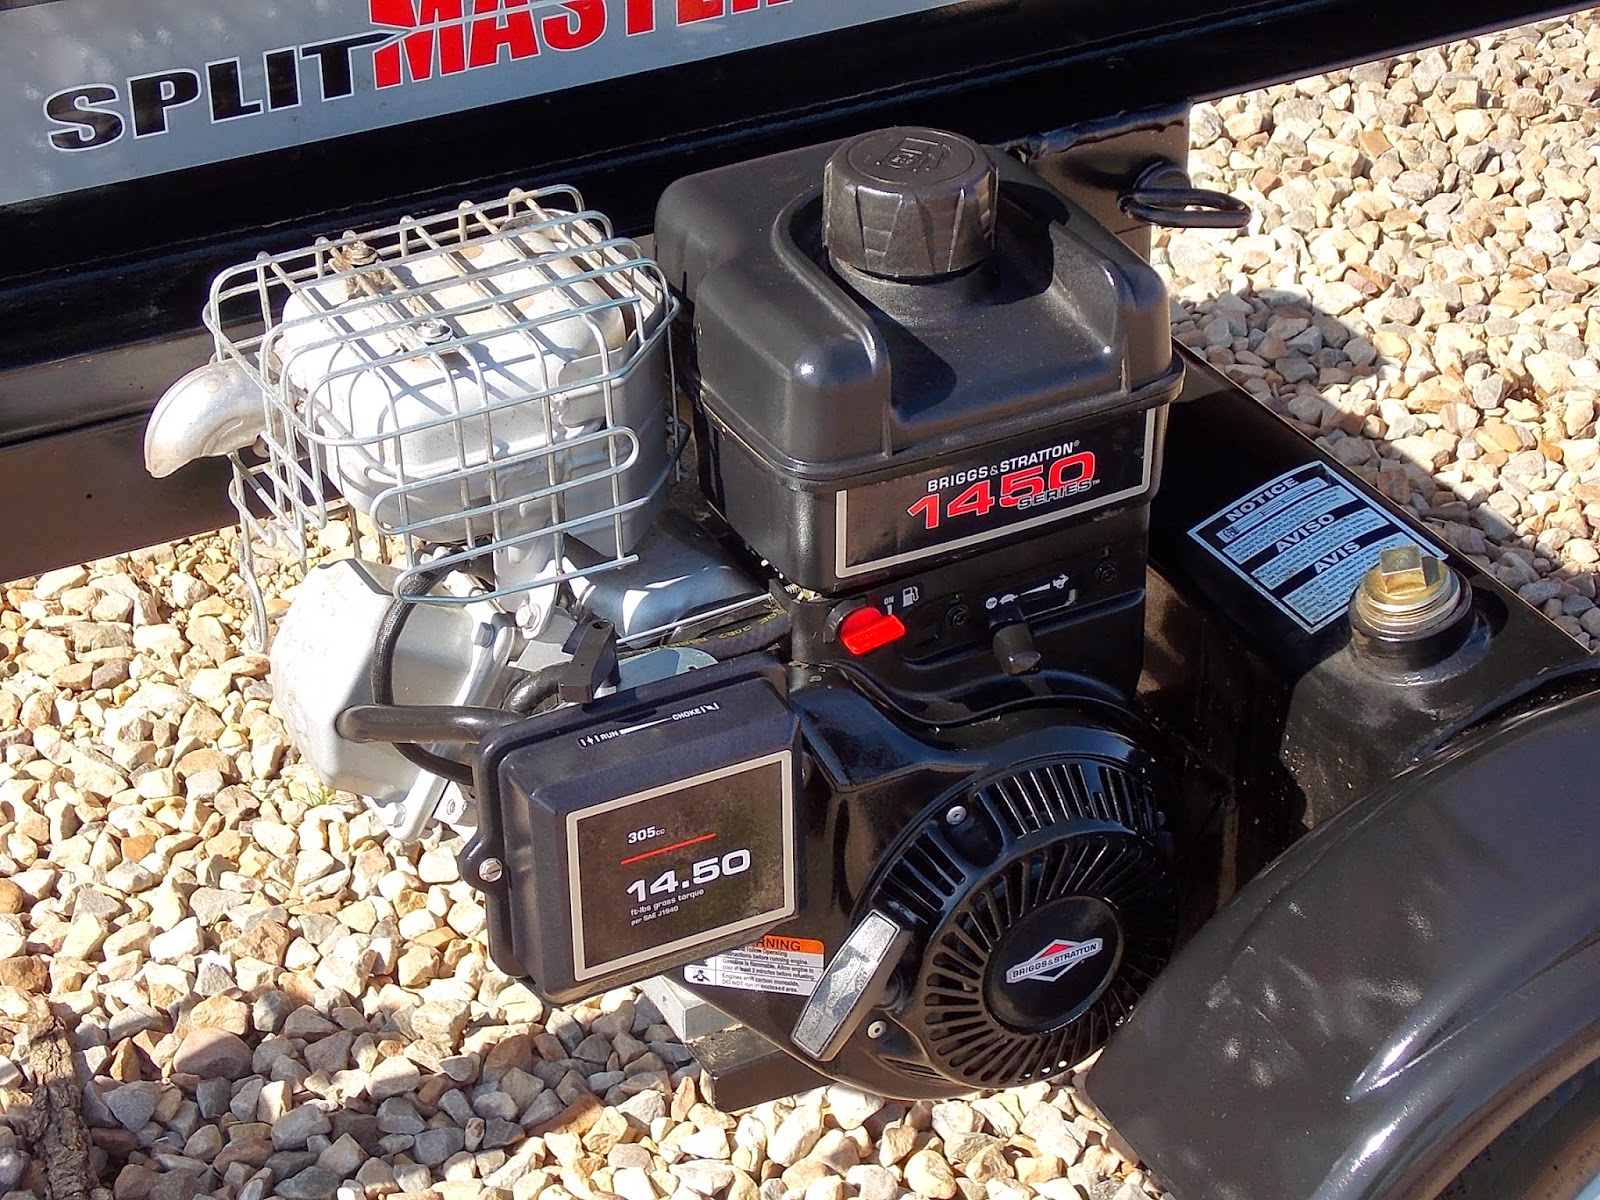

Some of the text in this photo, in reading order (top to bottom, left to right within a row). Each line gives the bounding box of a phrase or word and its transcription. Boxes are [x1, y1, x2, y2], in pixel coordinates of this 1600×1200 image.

[43, 31, 399, 152] SPLIT
[907, 451, 1095, 529] 1450
[1225, 478, 1300, 522] NOTICE
[1276, 514, 1335, 553] AVISO
[1314, 541, 1361, 574] AVIS
[600, 709, 701, 740] RUN CHOKE
[626, 849, 750, 902] 14.50
[630, 889, 704, 916] ft-lbs gross torque
[631, 918, 642, 926] per
[643, 912, 656, 921] SAE
[763, 948, 788, 958] Operating
[770, 957, 789, 965] running
[1012, 943, 1097, 978] BRIGGS&STRATTON
[722, 973, 743, 981] Engines
[756, 968, 775, 976] minutes
[791, 966, 808, 975] engine
[760, 984, 785, 992] enclosed
